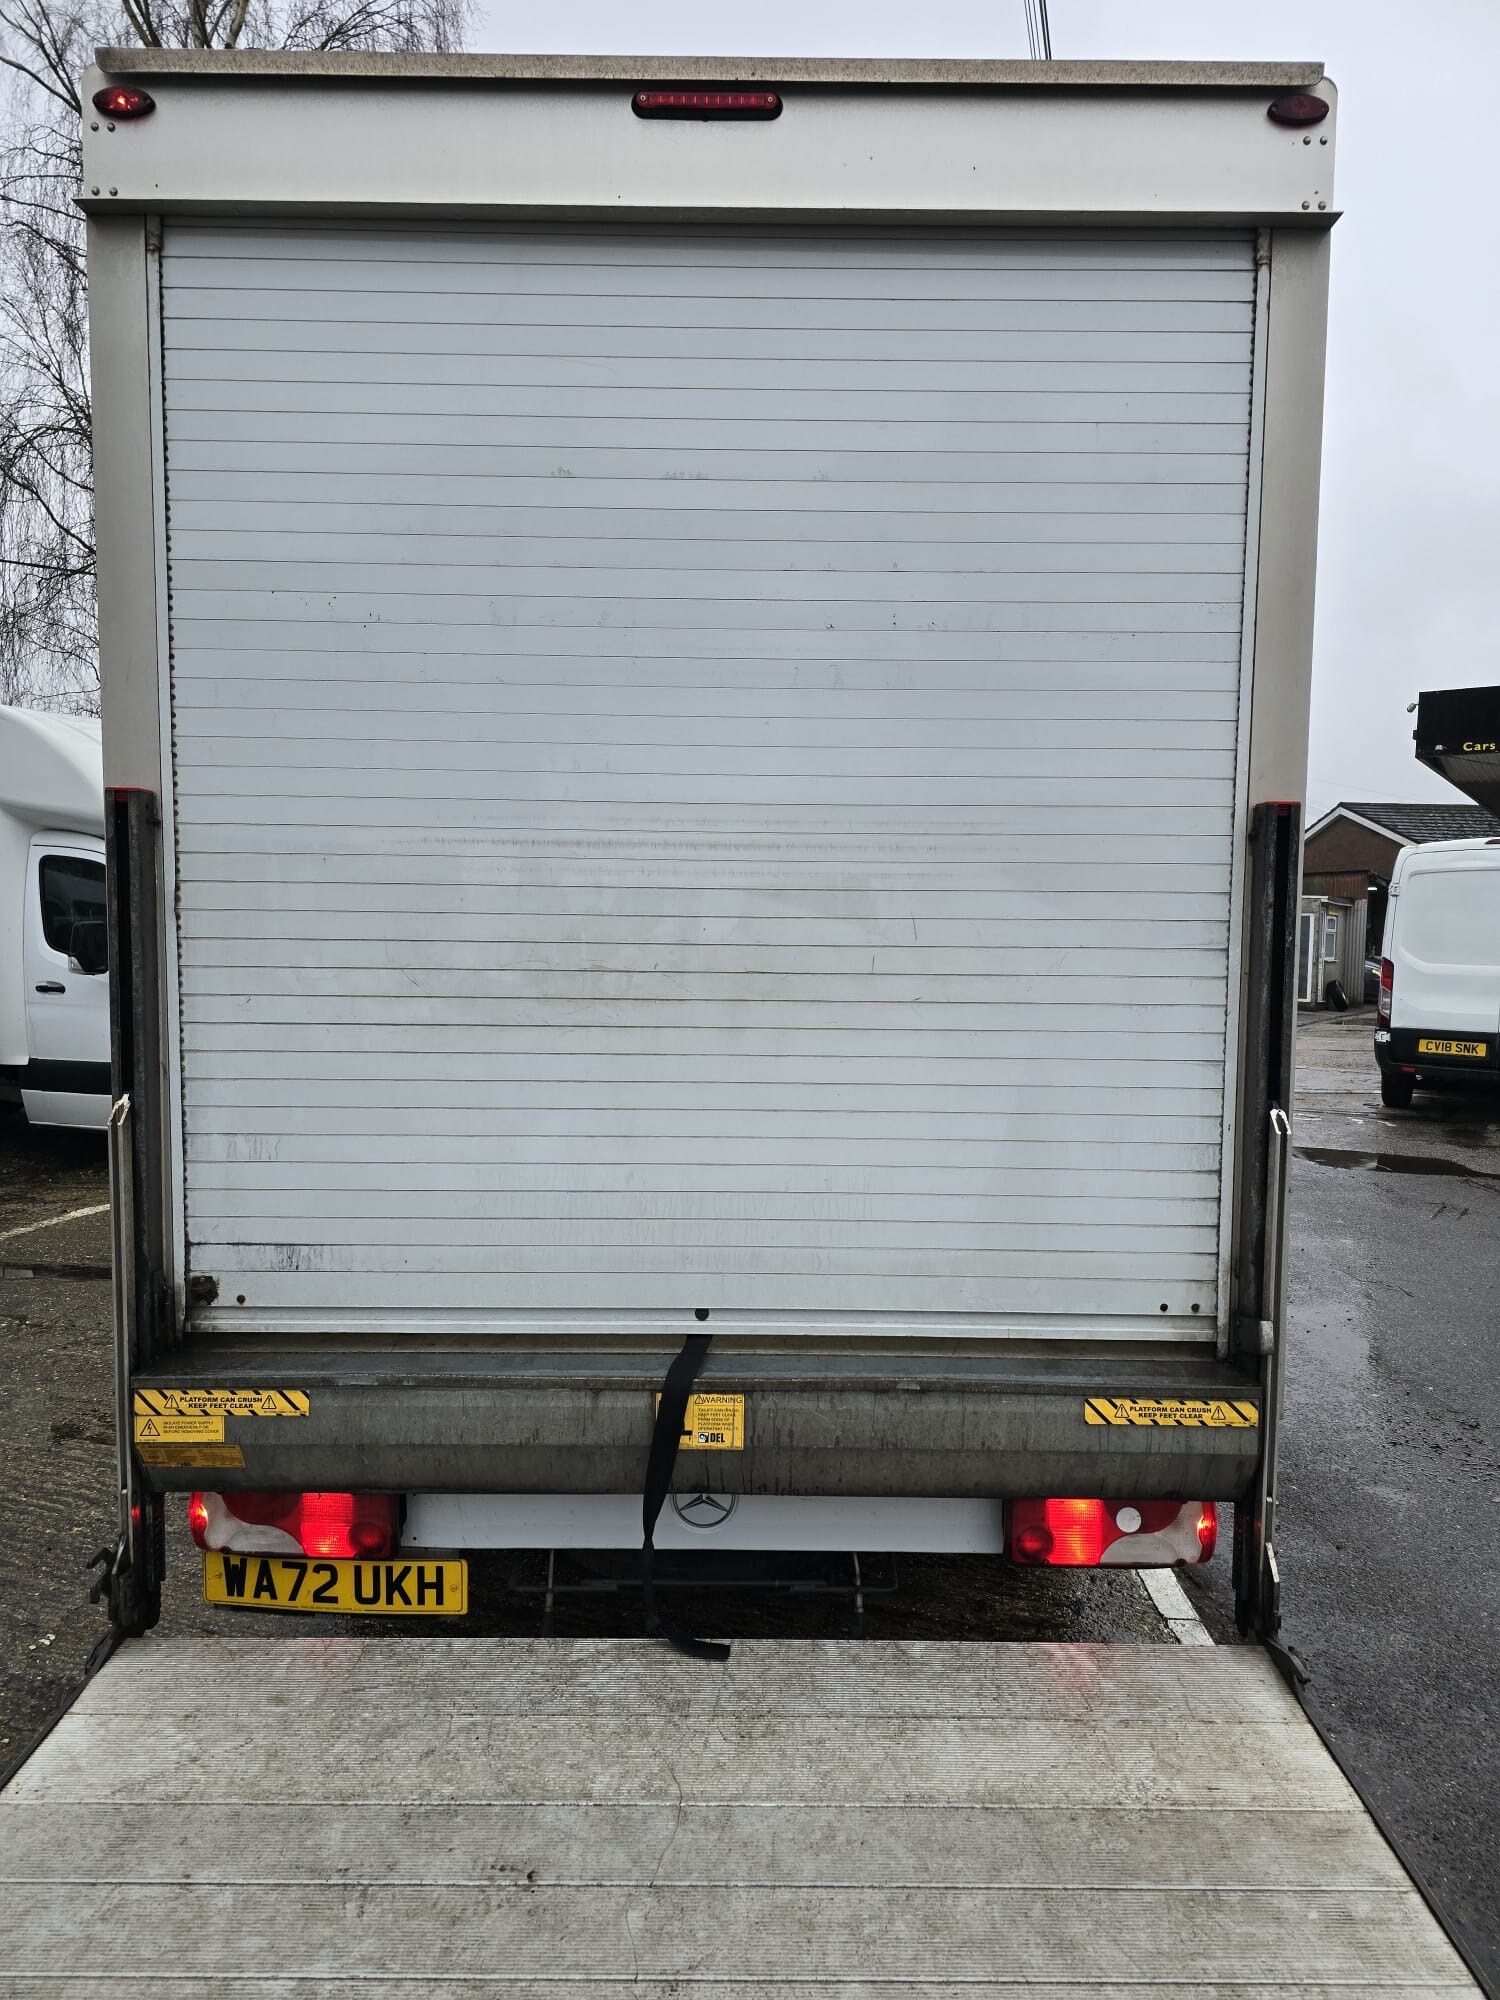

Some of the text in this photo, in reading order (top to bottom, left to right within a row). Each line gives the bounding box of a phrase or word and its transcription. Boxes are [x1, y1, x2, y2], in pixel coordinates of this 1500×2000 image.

[1463, 742, 1496, 751] Cars
[1426, 1041, 1480, 1054] CV18 SNK
[710, 1433, 726, 1443] DEL
[223, 1556, 444, 1606] WA72 UKH
